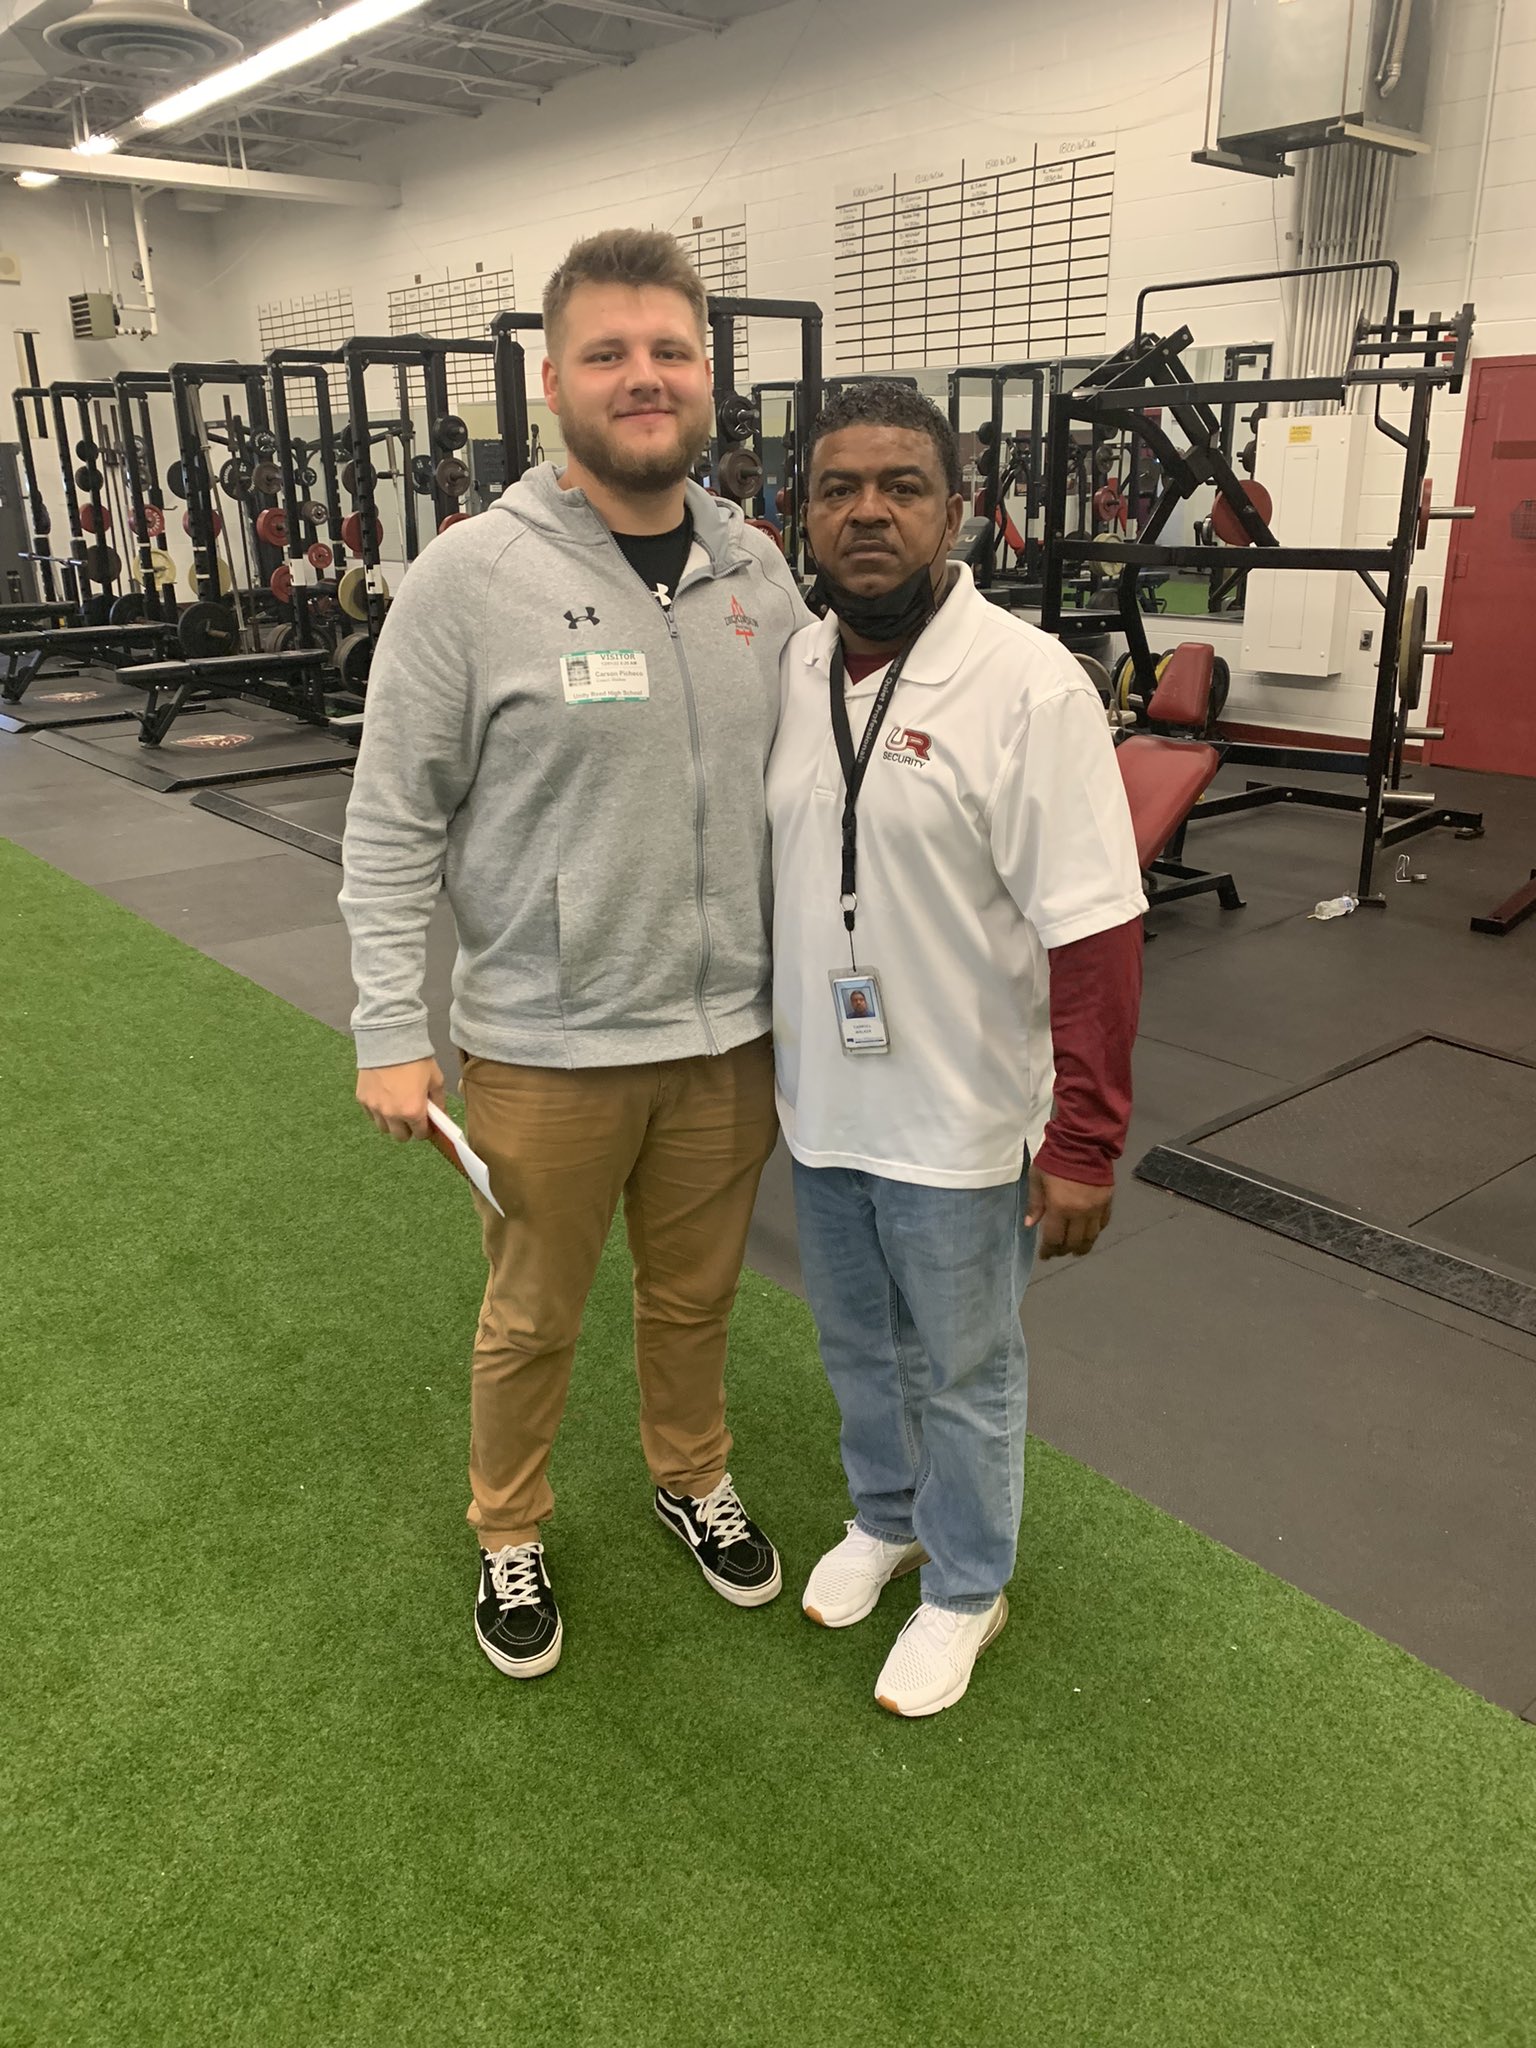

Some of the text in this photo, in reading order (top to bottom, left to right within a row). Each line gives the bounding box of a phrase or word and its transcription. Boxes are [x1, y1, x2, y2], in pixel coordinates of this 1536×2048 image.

[600, 653, 636, 661] VISITOR
[879, 677, 893, 702] Quiet
[857, 704, 883, 764] Professionals
[882, 750, 926, 769] SECURITY
